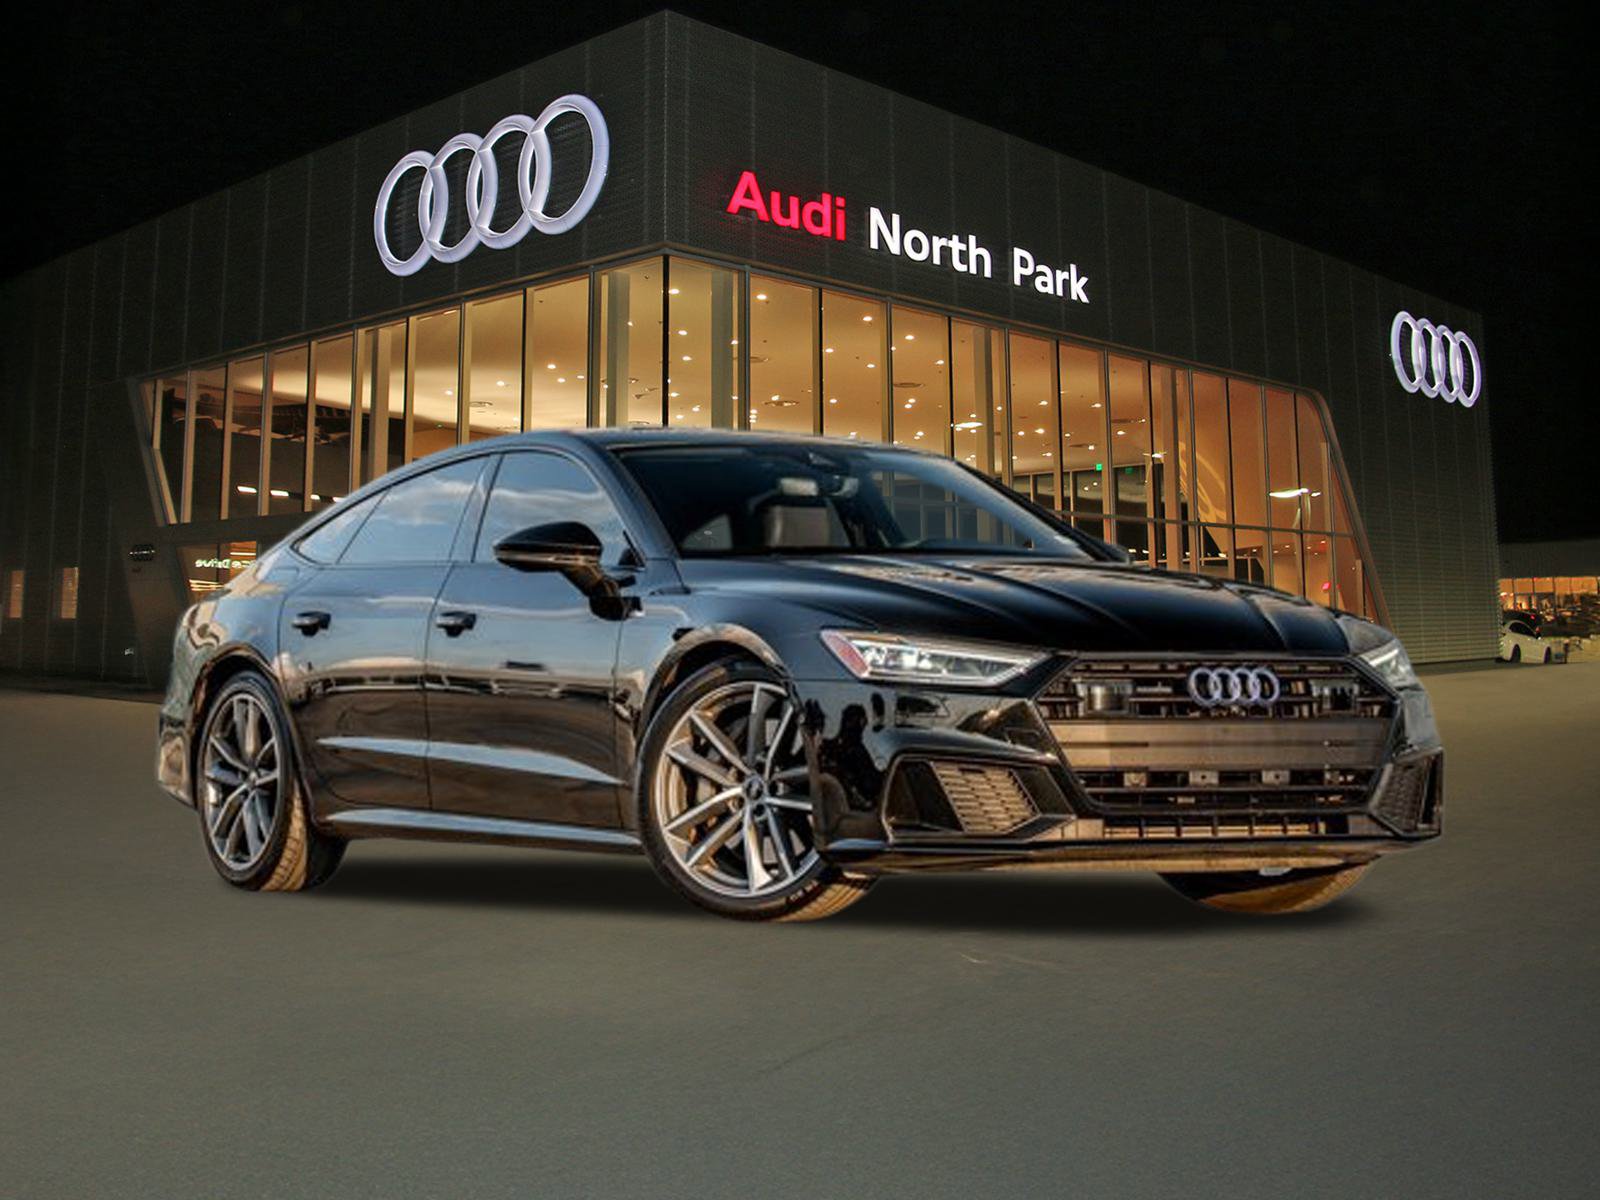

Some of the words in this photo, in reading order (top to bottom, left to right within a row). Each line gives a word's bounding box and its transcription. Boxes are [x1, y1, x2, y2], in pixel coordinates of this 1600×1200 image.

[727, 171, 845, 240] Audi
[870, 207, 991, 277] North
[1014, 247, 1089, 303] Park
